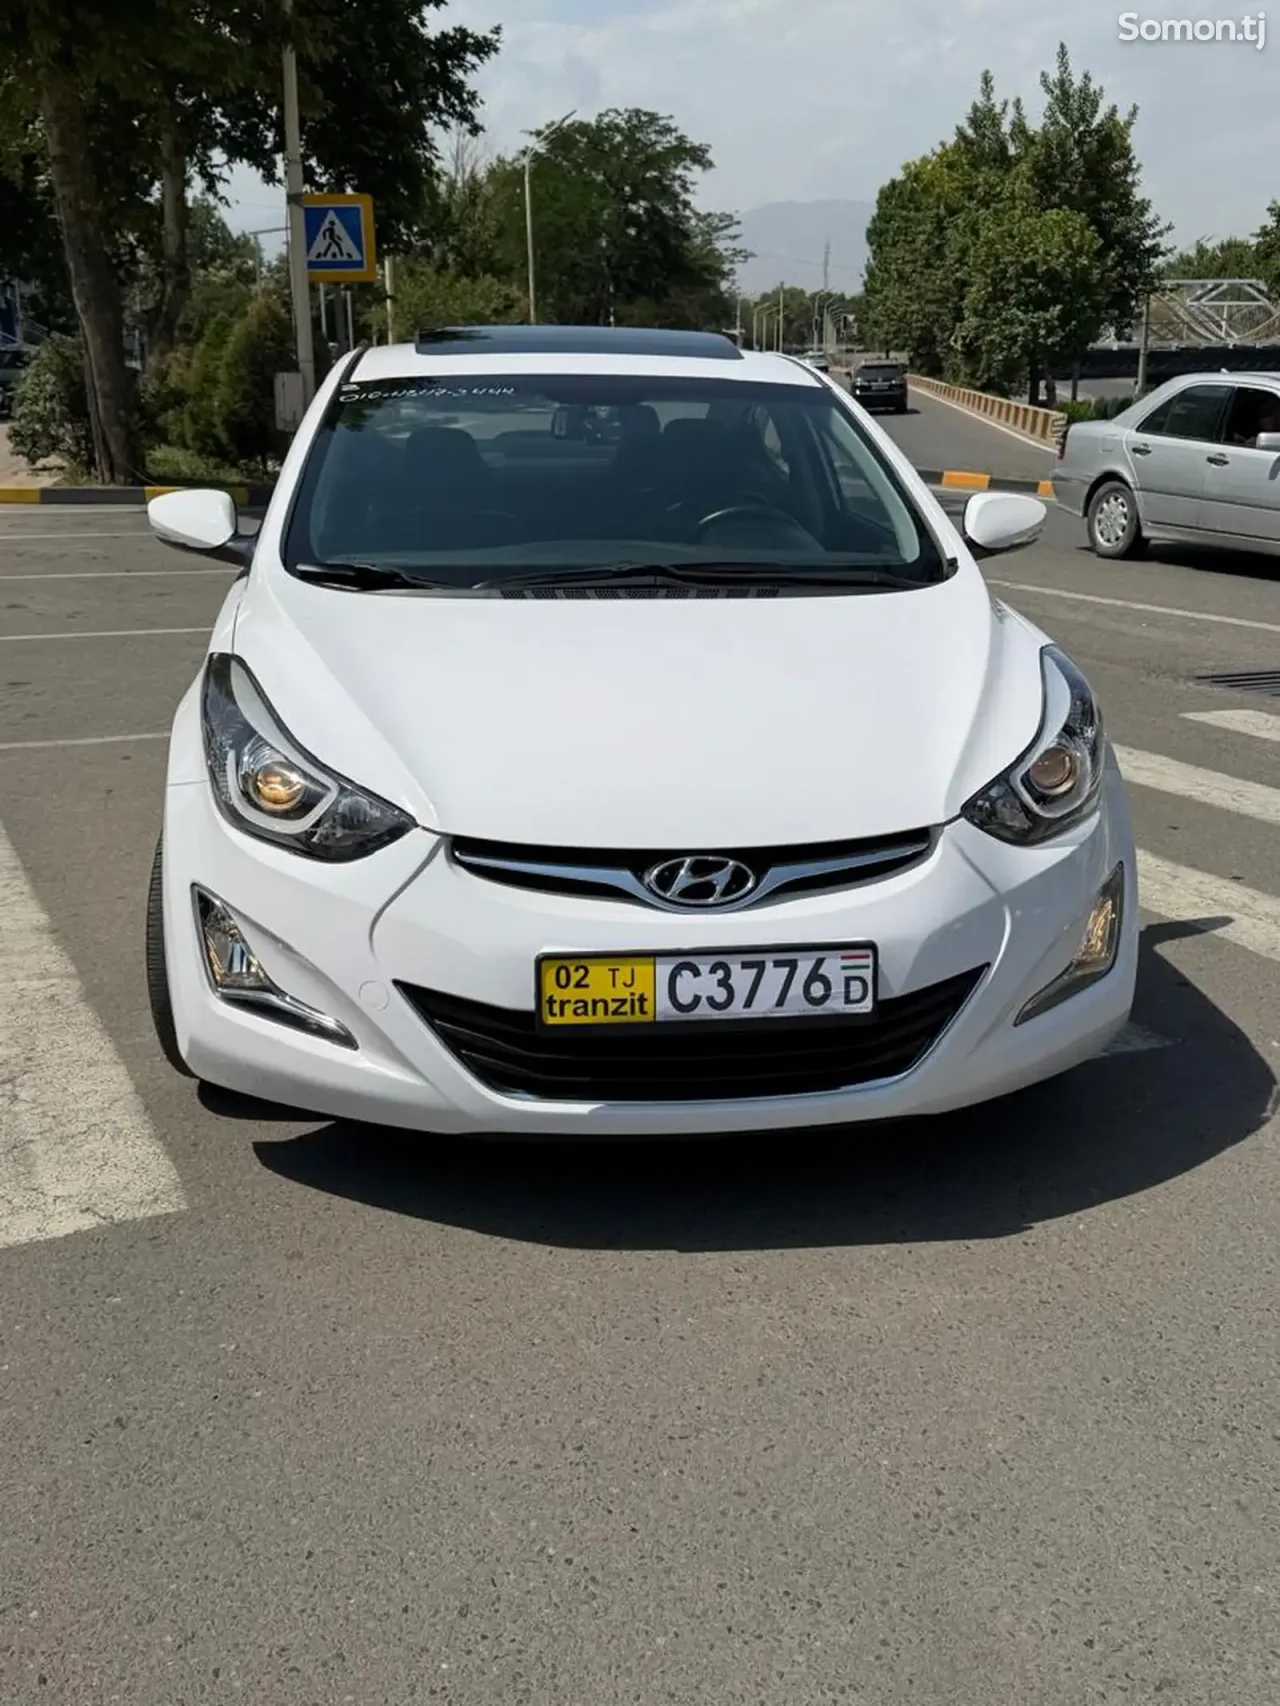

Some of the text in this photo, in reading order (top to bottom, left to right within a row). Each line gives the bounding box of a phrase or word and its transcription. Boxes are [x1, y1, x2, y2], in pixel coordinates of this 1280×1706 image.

[554, 964, 636, 990] 02 TJ
[667, 957, 869, 1014] C3776 D
[546, 991, 649, 1018] tranzit
